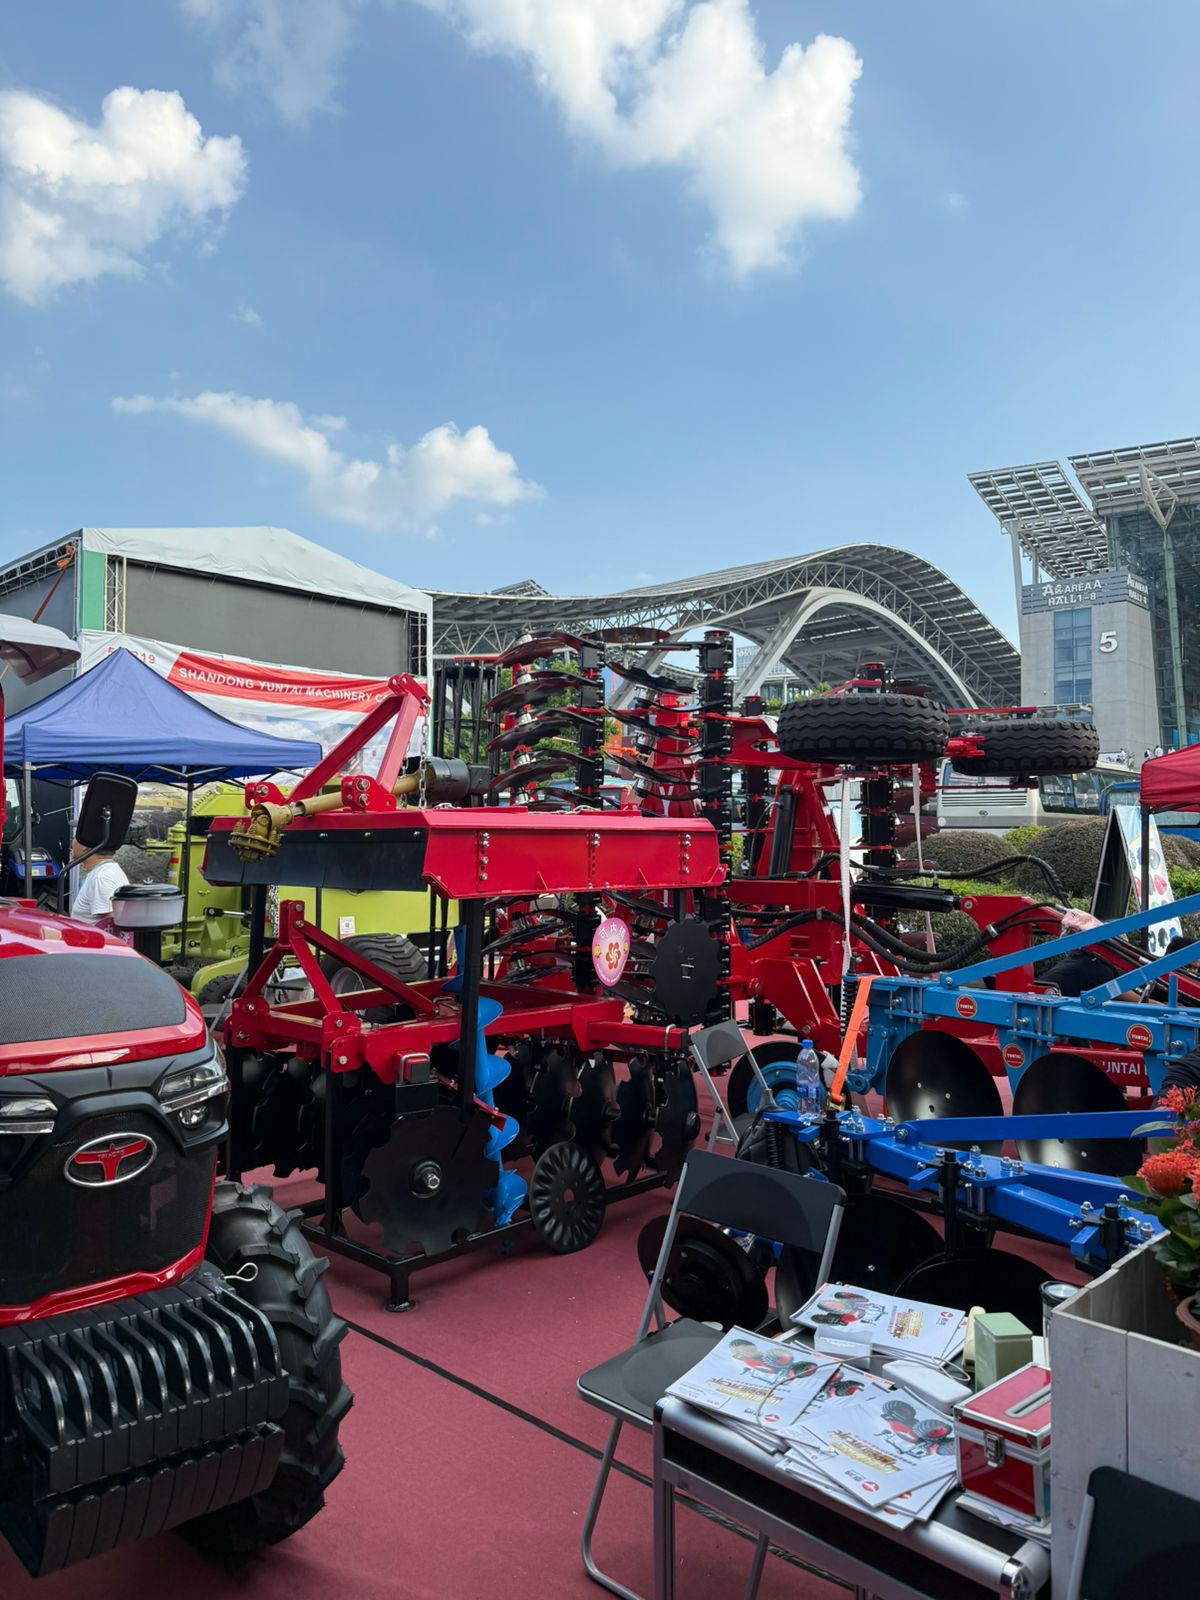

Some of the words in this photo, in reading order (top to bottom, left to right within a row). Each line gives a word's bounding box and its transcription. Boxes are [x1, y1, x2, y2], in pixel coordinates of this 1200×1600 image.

[1093, 579, 1102, 589] A
[1099, 630, 1118, 653] 5
[178, 667, 254, 689] SHANDONG
[258, 680, 303, 695] YUNTAI
[306, 687, 371, 702] MACHINERY
[1102, 1061, 1141, 1076] UNTAI
